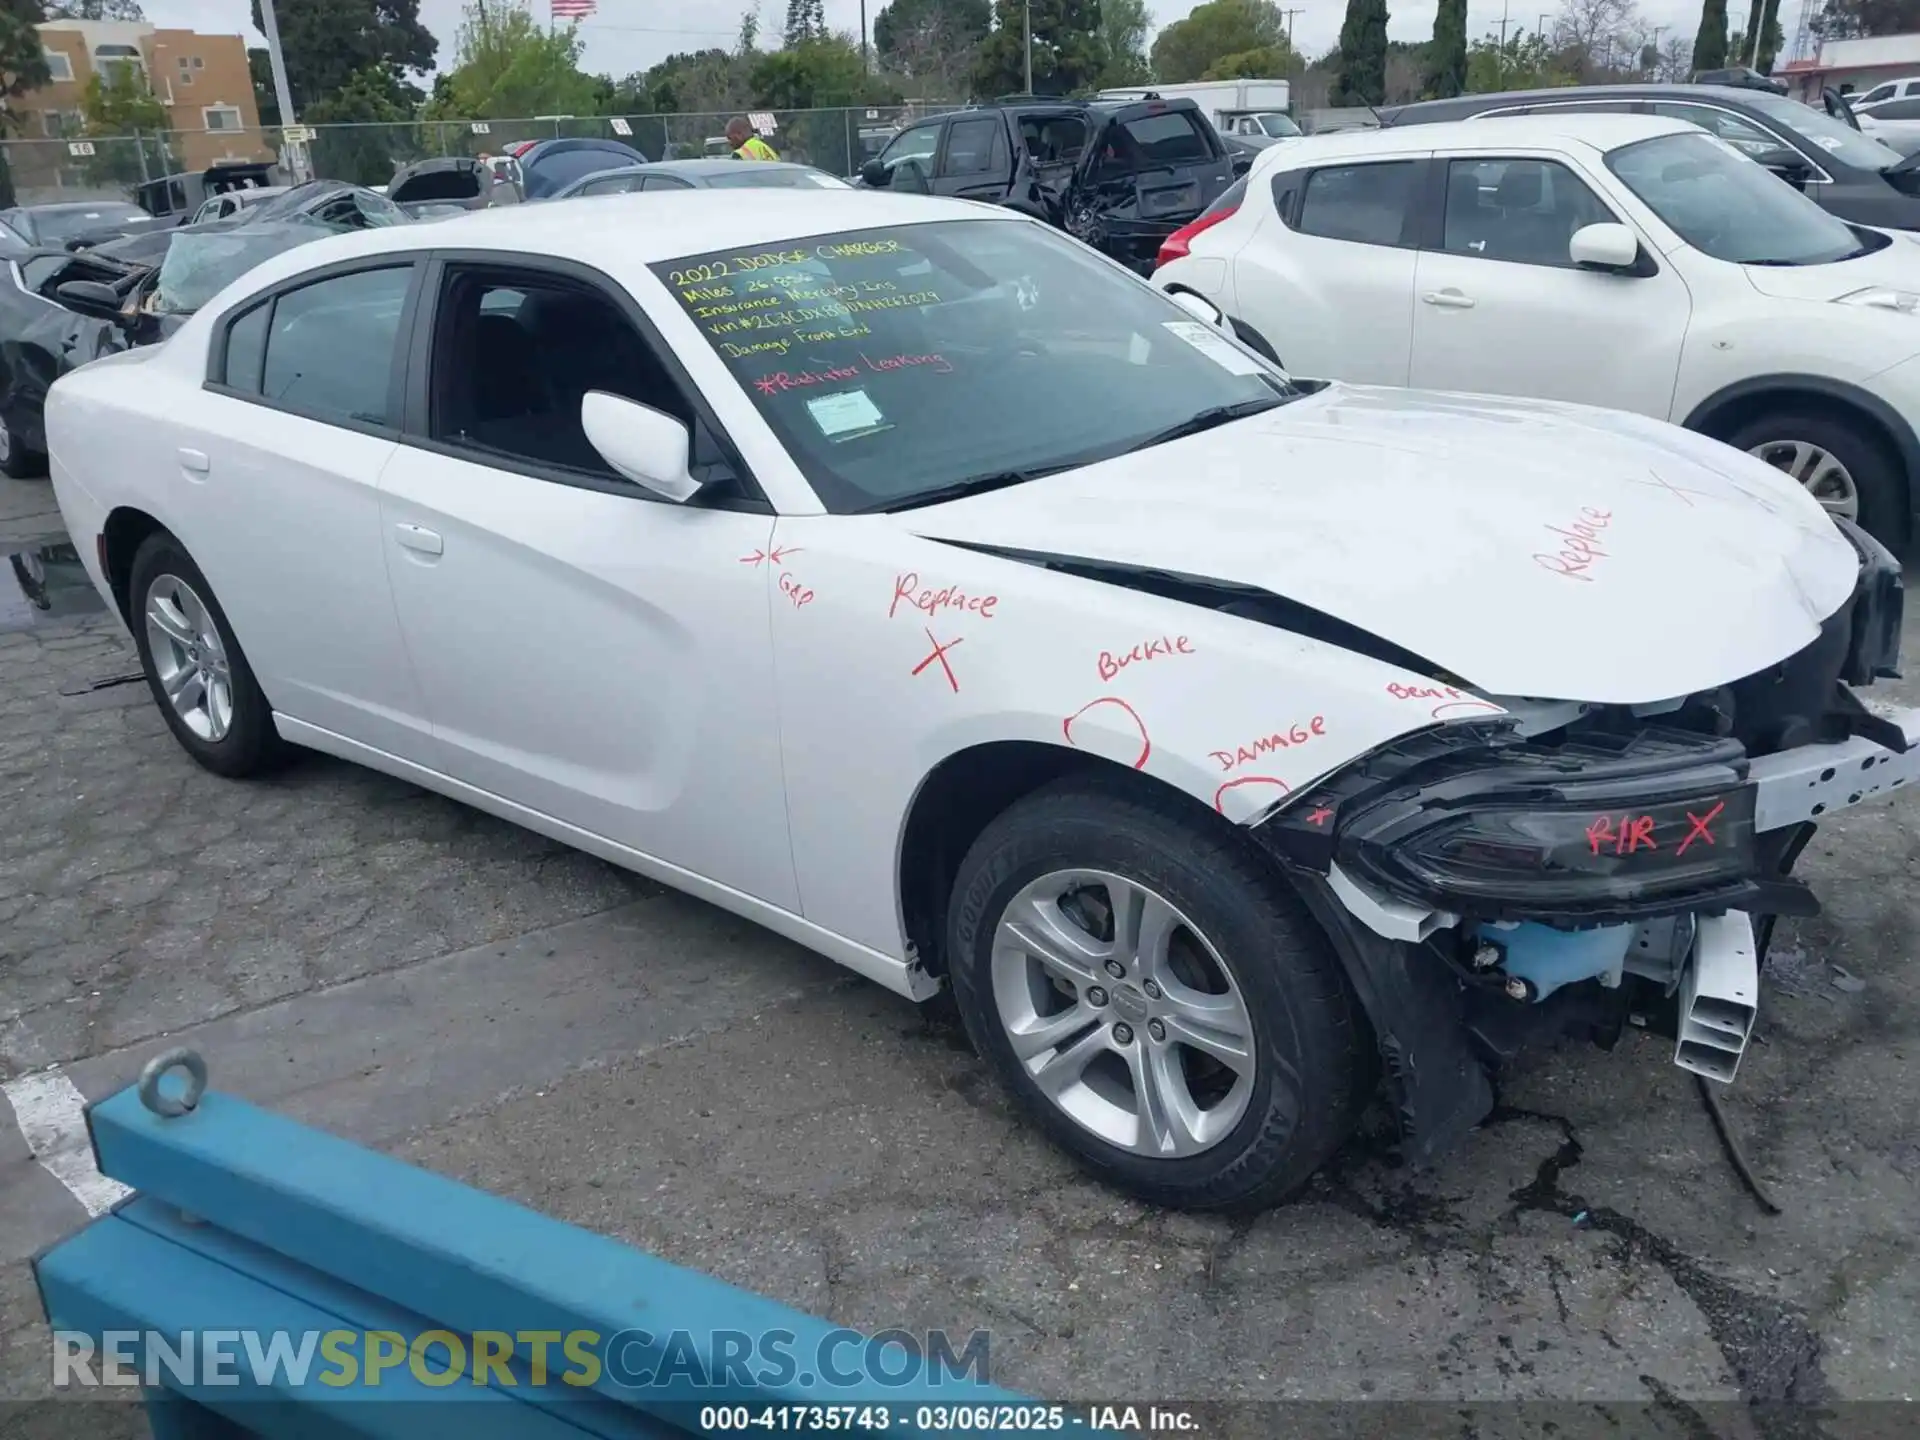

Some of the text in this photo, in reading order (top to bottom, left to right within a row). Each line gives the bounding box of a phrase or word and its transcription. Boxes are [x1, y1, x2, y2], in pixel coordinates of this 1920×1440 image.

[670, 239, 900, 286] 2022 DODGE CHARGER
[682, 285, 735, 303] Miles
[694, 296, 782, 318] Insurance
[784, 284, 859, 302] Mercury
[720, 322, 872, 358] Damage Front End
[1532, 505, 1612, 582] Replace
[889, 572, 999, 618] Replace
